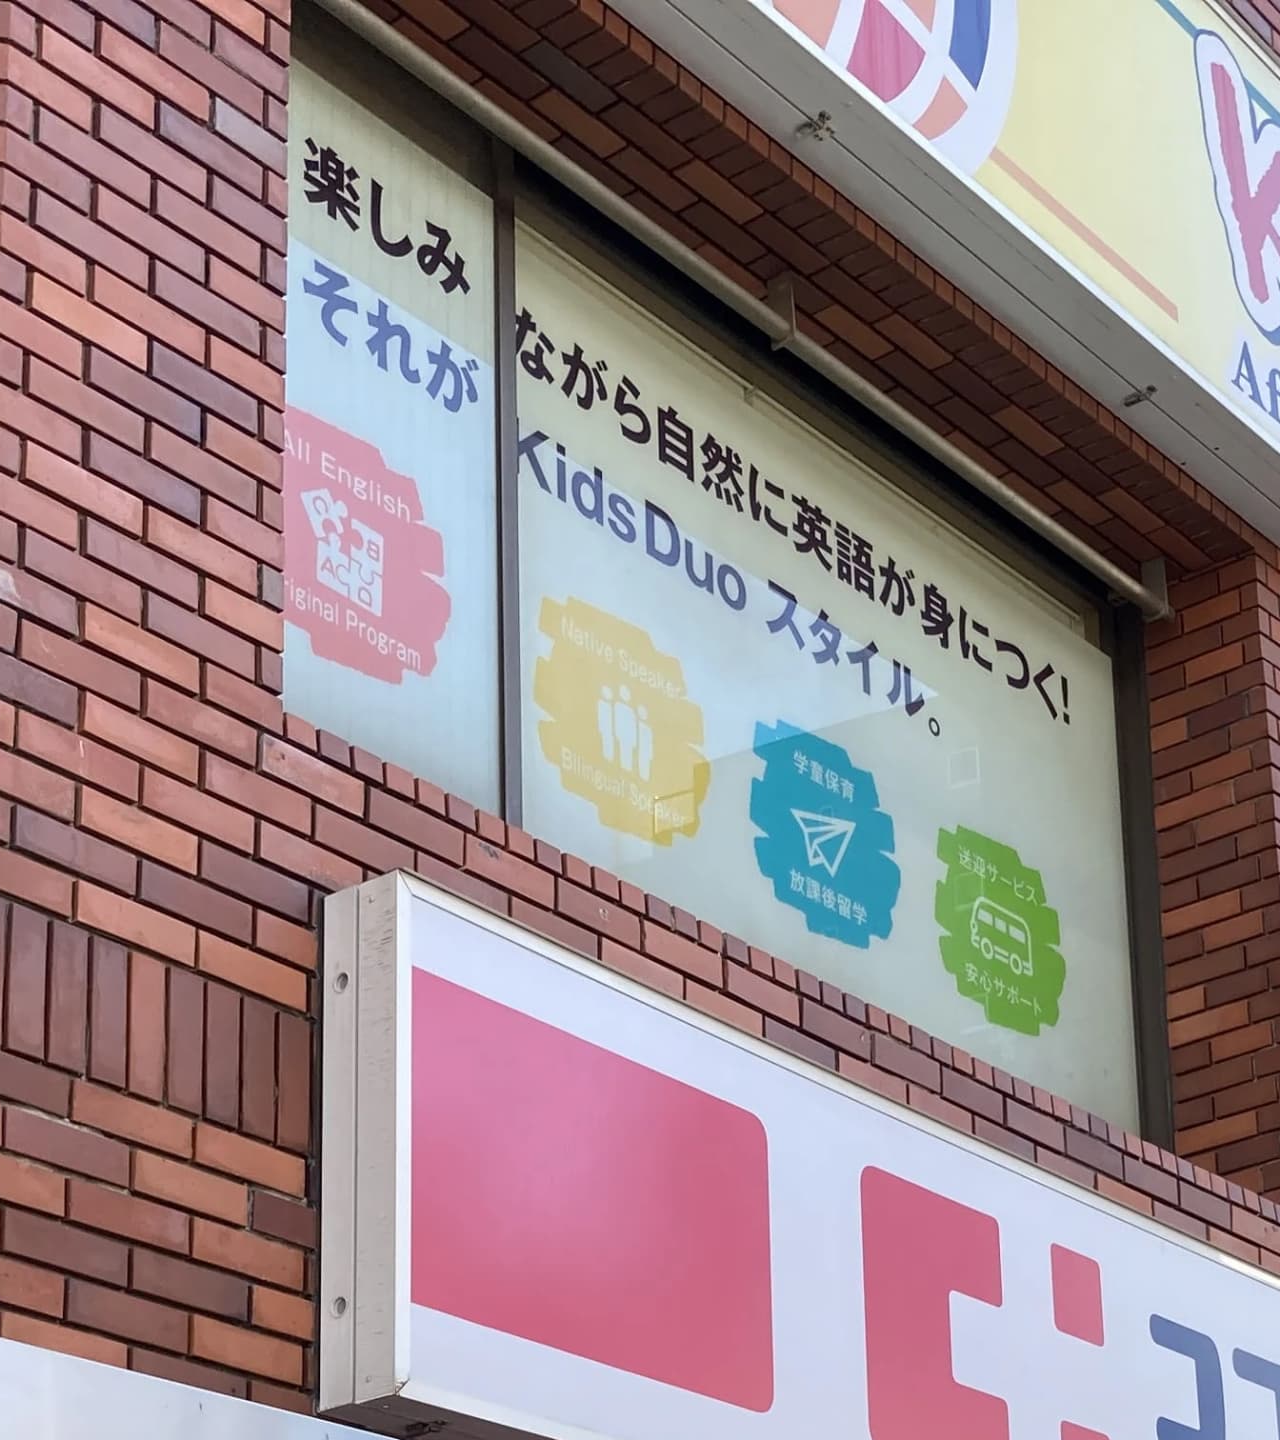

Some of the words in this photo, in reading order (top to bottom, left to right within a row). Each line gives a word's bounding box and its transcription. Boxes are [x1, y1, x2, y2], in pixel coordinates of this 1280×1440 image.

[303, 136, 471, 295] 楽しみ
[302, 259, 480, 413] それが
[320, 449, 412, 525] English
[345, 610, 422, 672] Program
[560, 615, 615, 665] Native
[618, 647, 684, 699] Speaker
[560, 745, 628, 803] Bilingual
[628, 782, 691, 832] Speaker
[791, 749, 856, 804] 学童保育
[788, 868, 869, 927] 放課後留学
[956, 844, 1040, 906] 送迎サービス
[963, 962, 1044, 1018] 安心サポート
